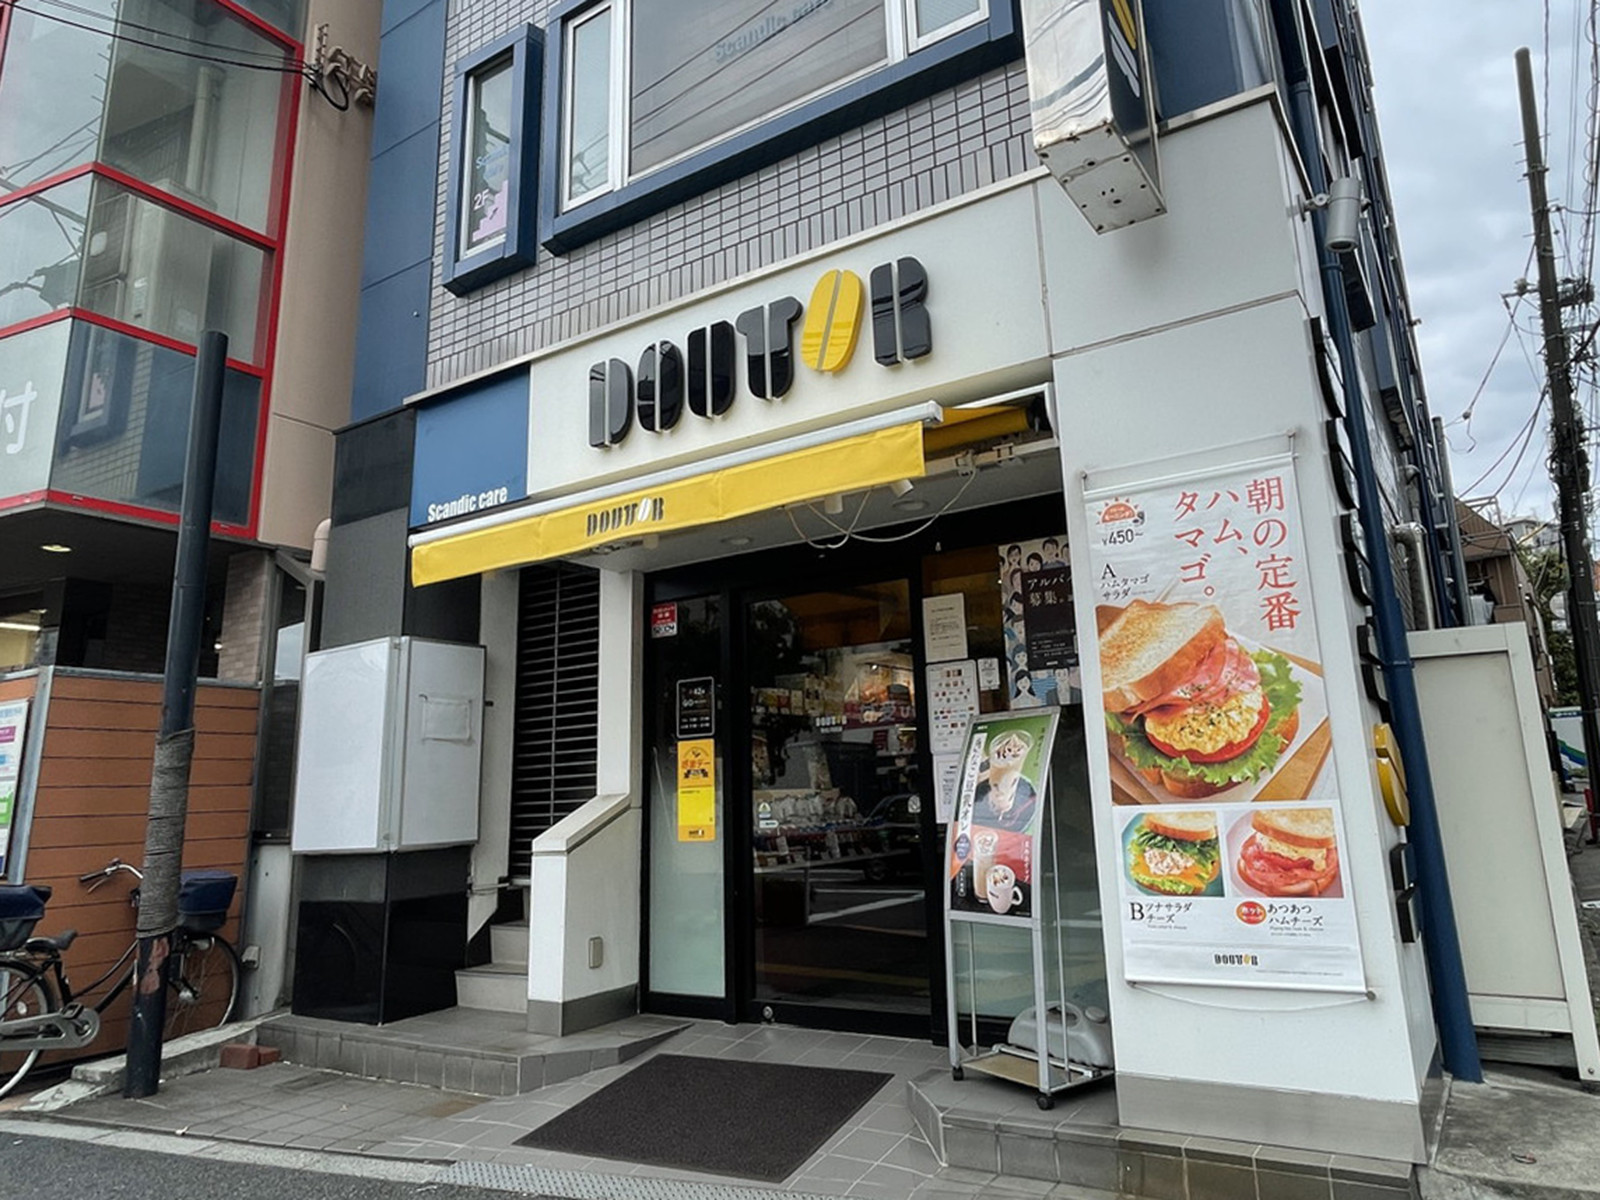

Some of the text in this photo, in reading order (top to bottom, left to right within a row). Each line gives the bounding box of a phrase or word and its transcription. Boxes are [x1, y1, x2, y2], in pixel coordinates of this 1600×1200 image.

[474, 188, 490, 210] 2F
[588, 255, 933, 449] DOUTOR
[427, 486, 508, 523] Scandic care
[586, 497, 665, 537] DOUTOR
[1206, 490, 1248, 555] ハム、
[1174, 490, 1215, 598] タマゴ。
[1246, 476, 1301, 632] 朝の定番
[1101, 563, 1117, 580] A
[1100, 573, 1150, 589] ハムタマゴ
[1102, 587, 1131, 601] サラダ
[1130, 902, 1145, 921] B
[1145, 901, 1193, 913] ツナサラダ
[1267, 903, 1313, 915] あつあつ
[1146, 913, 1175, 923] チーズ
[1268, 915, 1324, 927] ハムチーズ
[1214, 953, 1259, 967] DOUTOR
